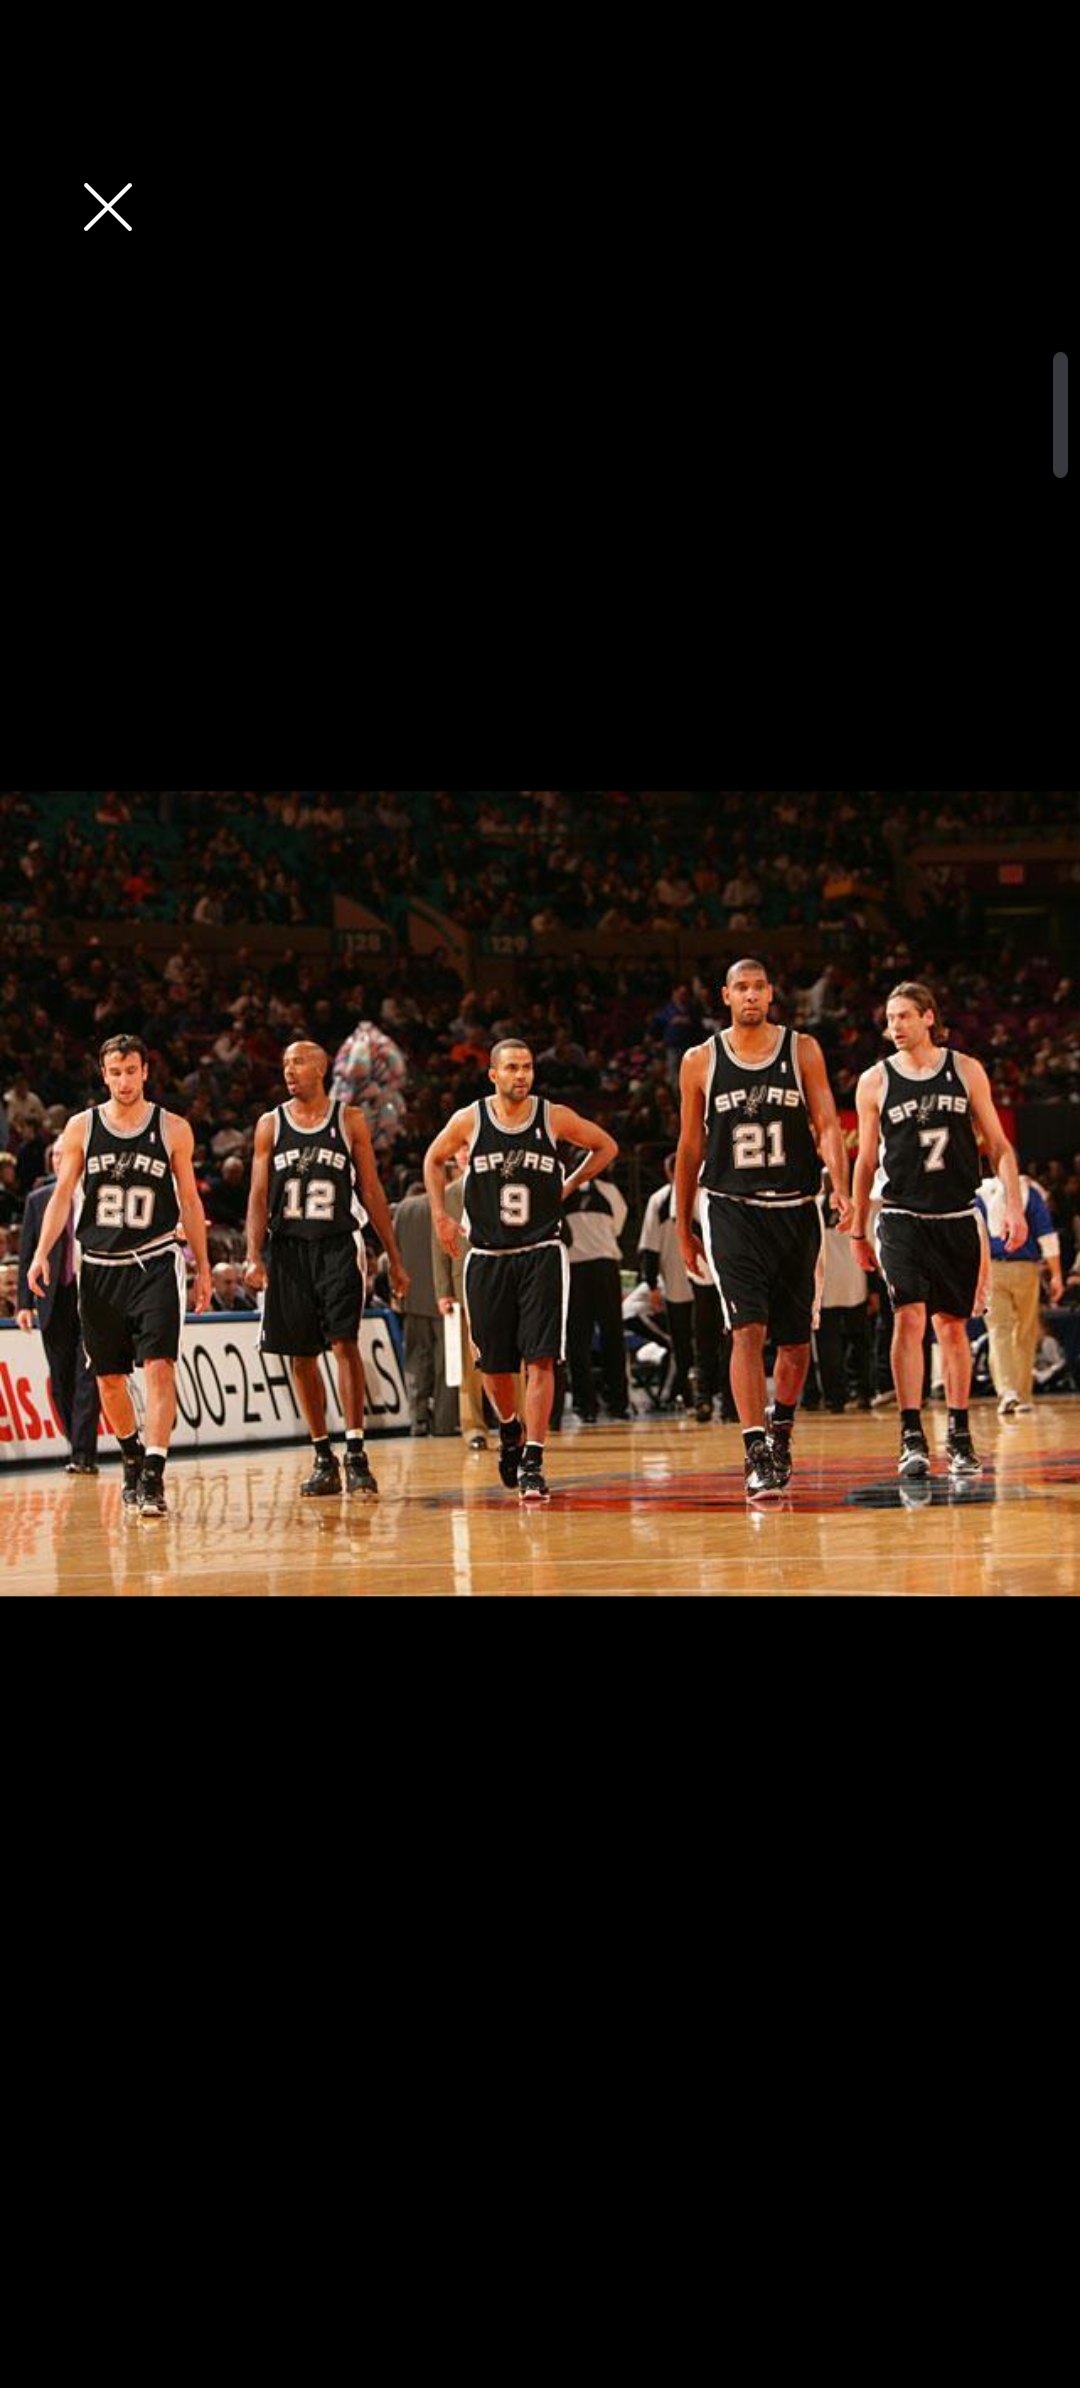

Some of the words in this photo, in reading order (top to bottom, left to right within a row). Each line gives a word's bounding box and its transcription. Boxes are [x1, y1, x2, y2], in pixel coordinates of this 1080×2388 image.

[714, 1085, 800, 1117] SPURS
[888, 1093, 967, 1126] SPURS
[273, 1146, 347, 1174] SPURS
[733, 1121, 786, 1169] 21
[918, 1126, 949, 1172] 7
[87, 1152, 167, 1181] SPURS
[473, 1149, 555, 1179] SPURS
[96, 1184, 155, 1229] 20
[283, 1178, 336, 1220] 12
[500, 1183, 530, 1227] 9
